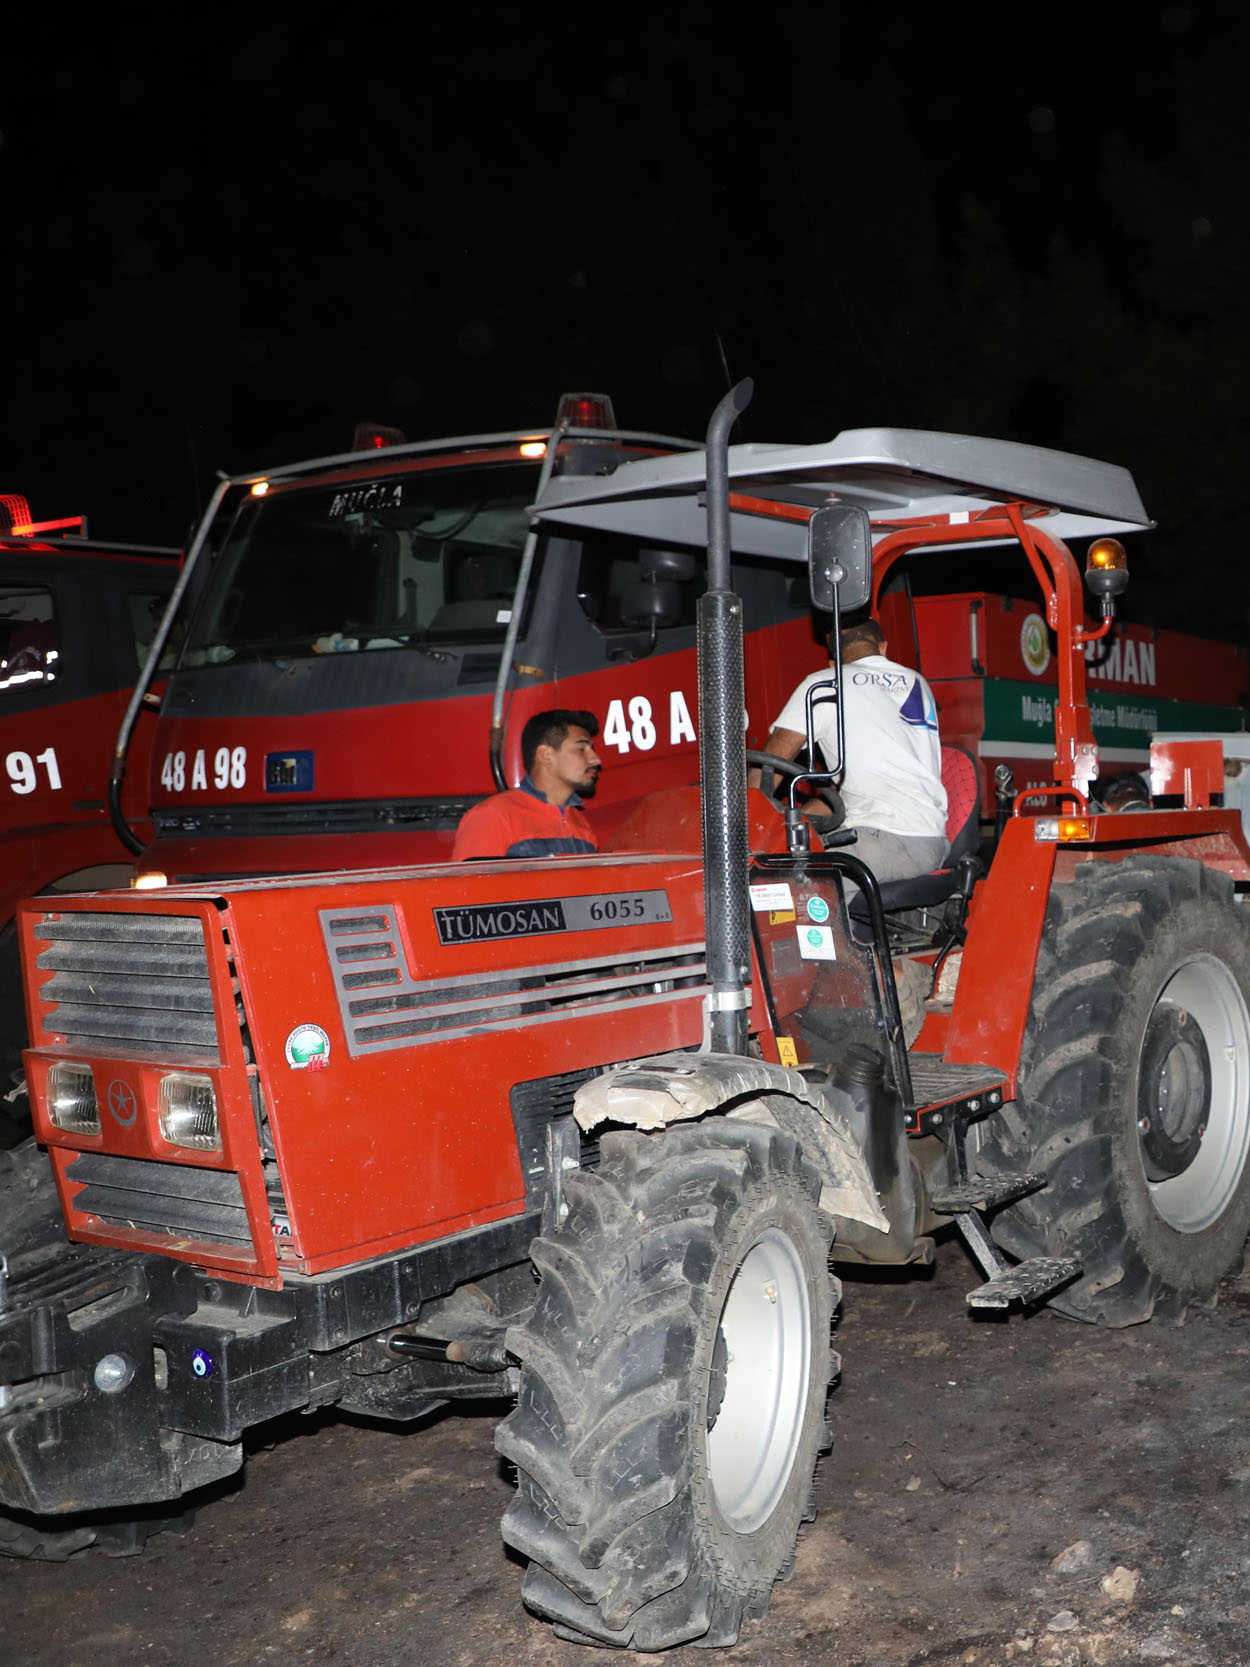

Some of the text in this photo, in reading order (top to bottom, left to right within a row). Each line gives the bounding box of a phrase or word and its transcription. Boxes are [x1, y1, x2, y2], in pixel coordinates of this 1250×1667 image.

[852, 671, 908, 687] ORSA
[603, 695, 657, 754] 48
[669, 691, 697, 745] A
[6, 747, 62, 794] 91
[161, 746, 247, 792] 48 A 98
[440, 898, 645, 938] TÜMOSAN 6055
